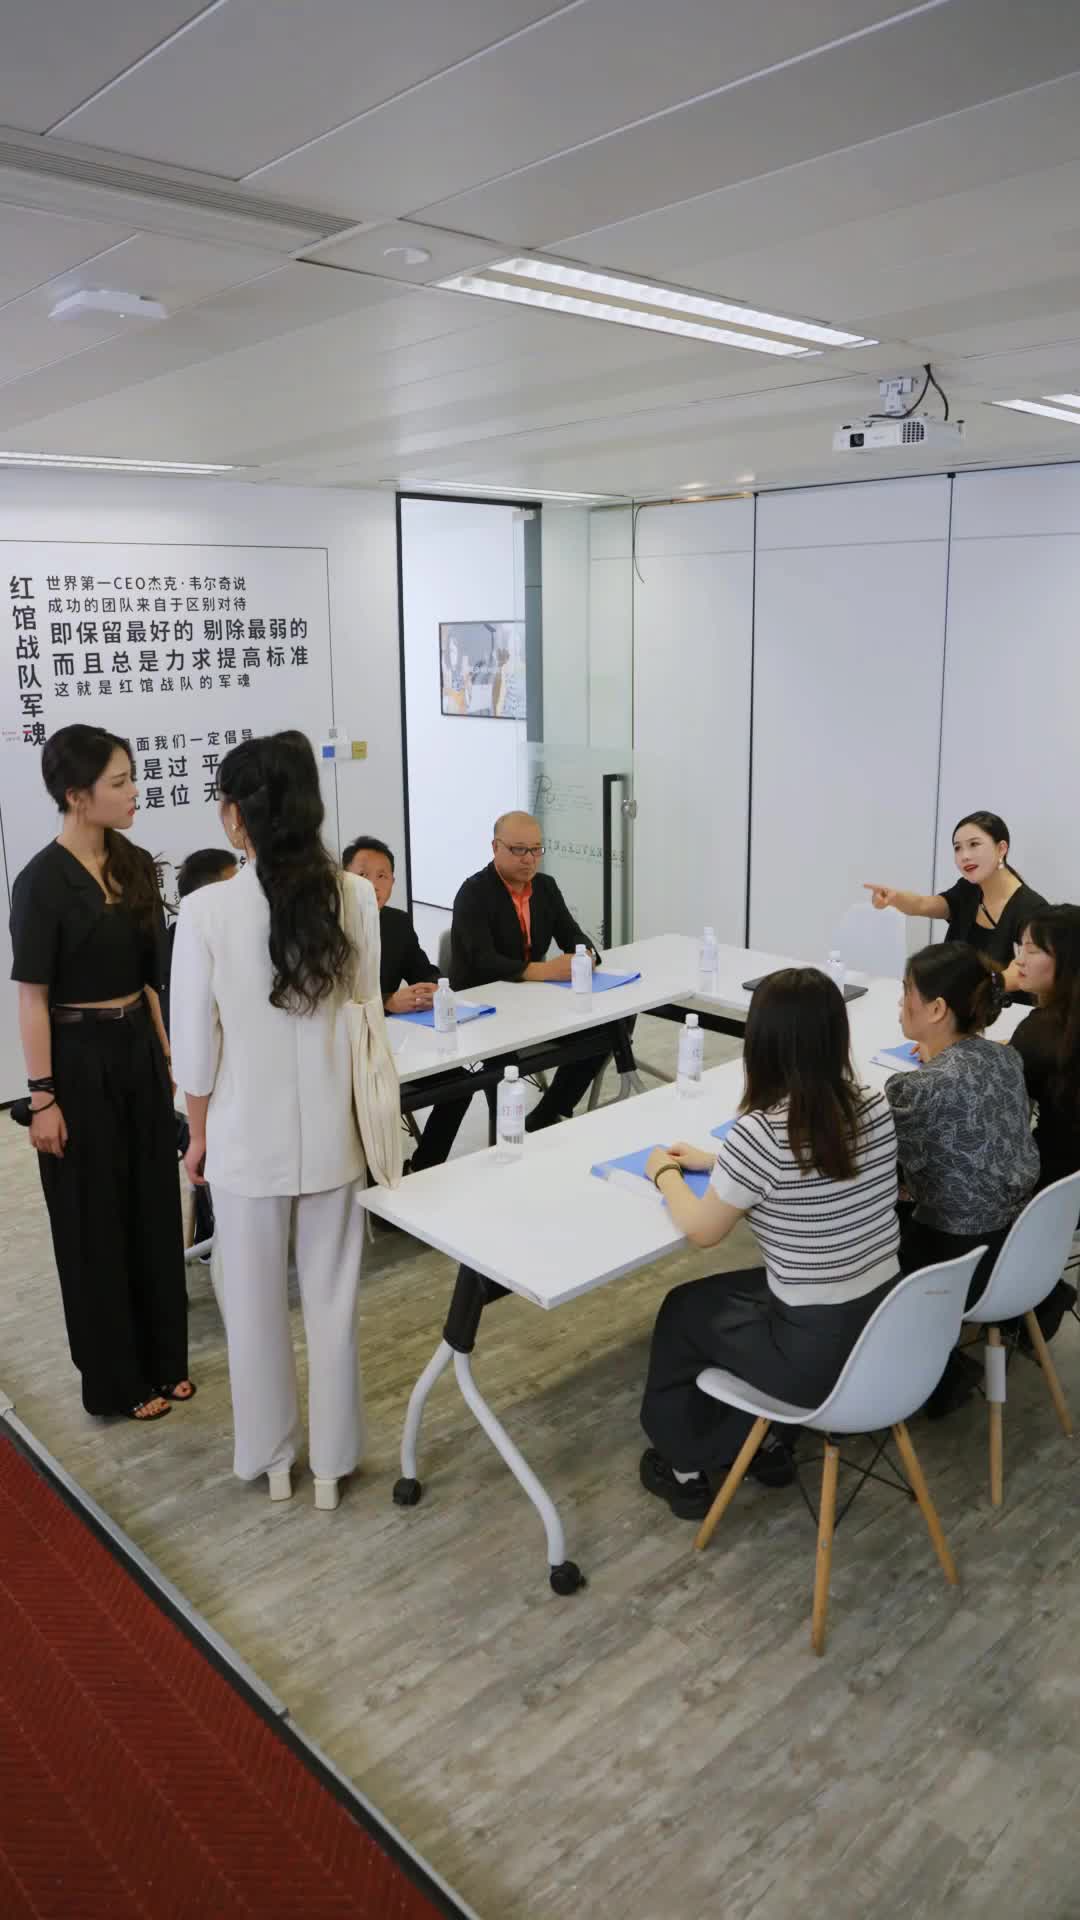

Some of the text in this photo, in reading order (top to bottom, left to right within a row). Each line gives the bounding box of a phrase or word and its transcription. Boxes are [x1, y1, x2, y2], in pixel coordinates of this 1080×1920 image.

[48, 596, 247, 614] 成功的团队来自于区别对待
[50, 617, 308, 646] 即保留最好的 剔除最弱的
[9, 575, 47, 747] 红馆战队军魂
[52, 645, 309, 677] 而且总是力求提高标准
[54, 673, 251, 698] 这就是红馆战队的军魂
[125, 728, 254, 753] 面我们一定倡导
[131, 755, 189, 782] 是过
[133, 783, 190, 810] 是位
